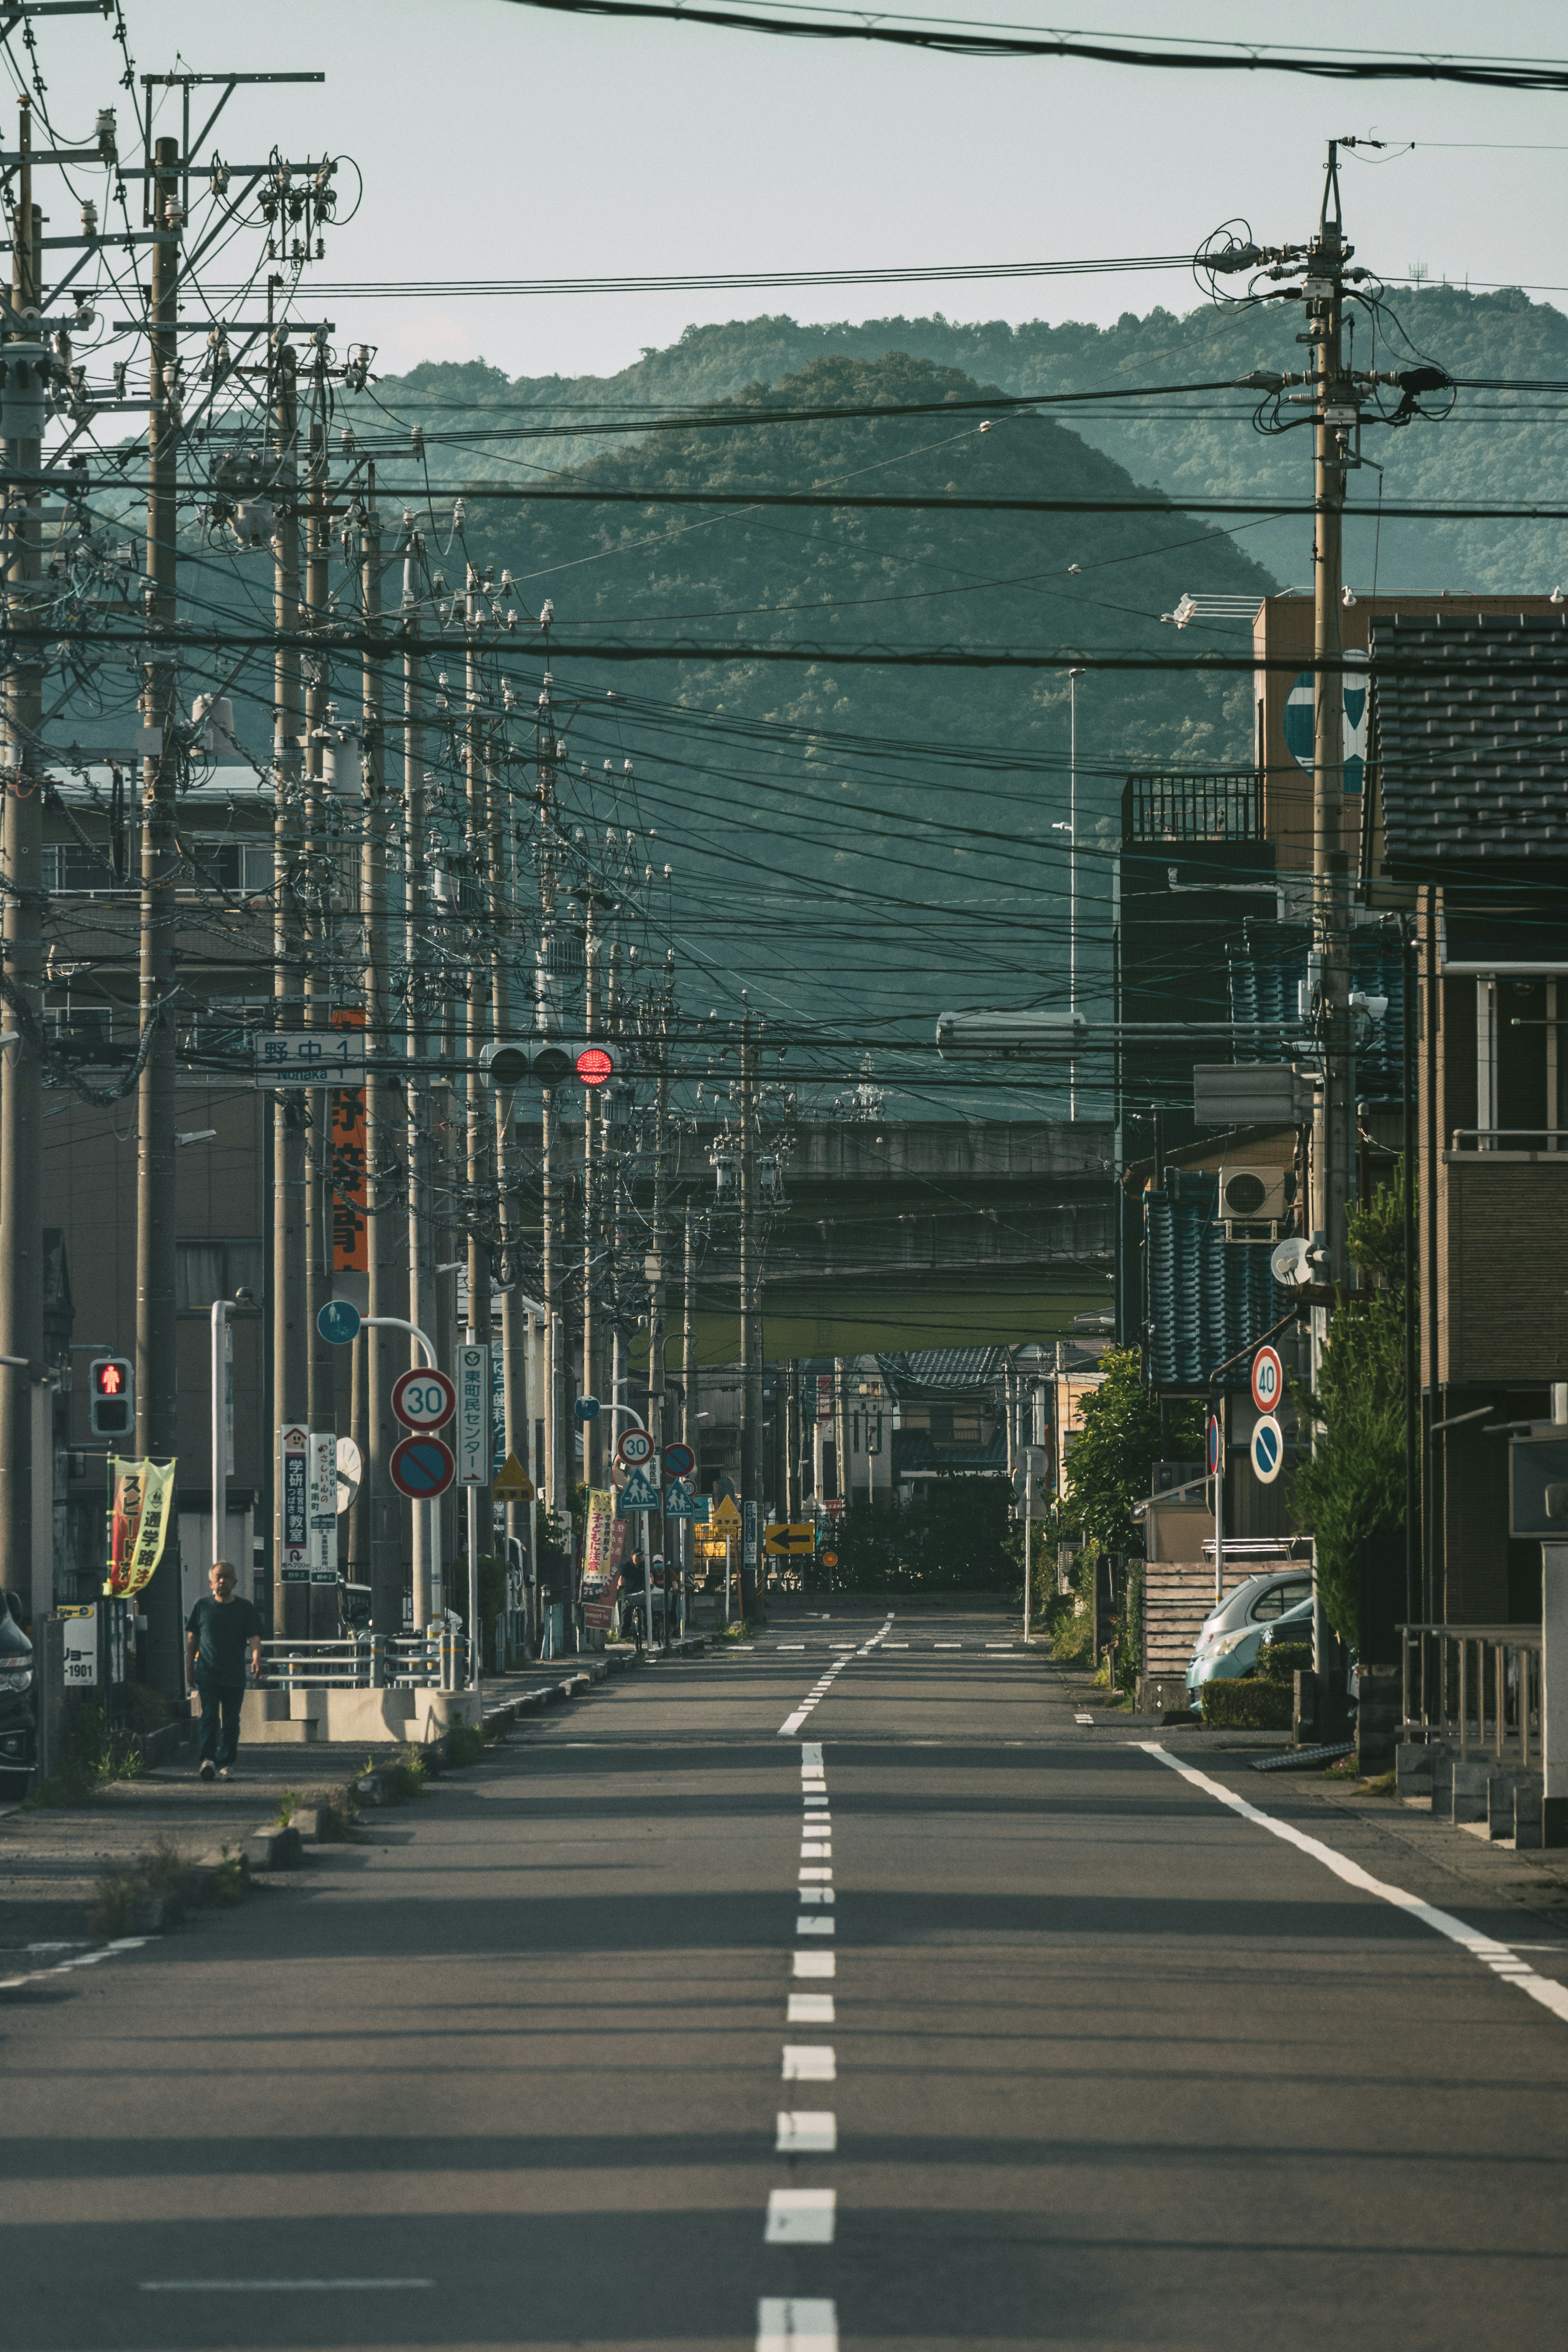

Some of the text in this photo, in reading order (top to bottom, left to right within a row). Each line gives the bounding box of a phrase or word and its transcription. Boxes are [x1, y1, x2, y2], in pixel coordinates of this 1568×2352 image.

[277, 1069, 327, 1080] Nonaka
[1259, 1366, 1274, 1393] 40
[408, 1387, 442, 1414] 30
[464, 1370, 481, 1468] 東町民センター
[626, 1439, 646, 1455] 30
[289, 1459, 303, 1487] 学研
[318, 1443, 328, 1503] やさしい心の
[287, 1488, 296, 1514] つばさ
[684, 1484, 693, 1492] 30
[289, 1515, 303, 1541] 教室
[588, 1512, 604, 1571] 子どもに注意
[602, 1514, 612, 1561] 学童横断多し
